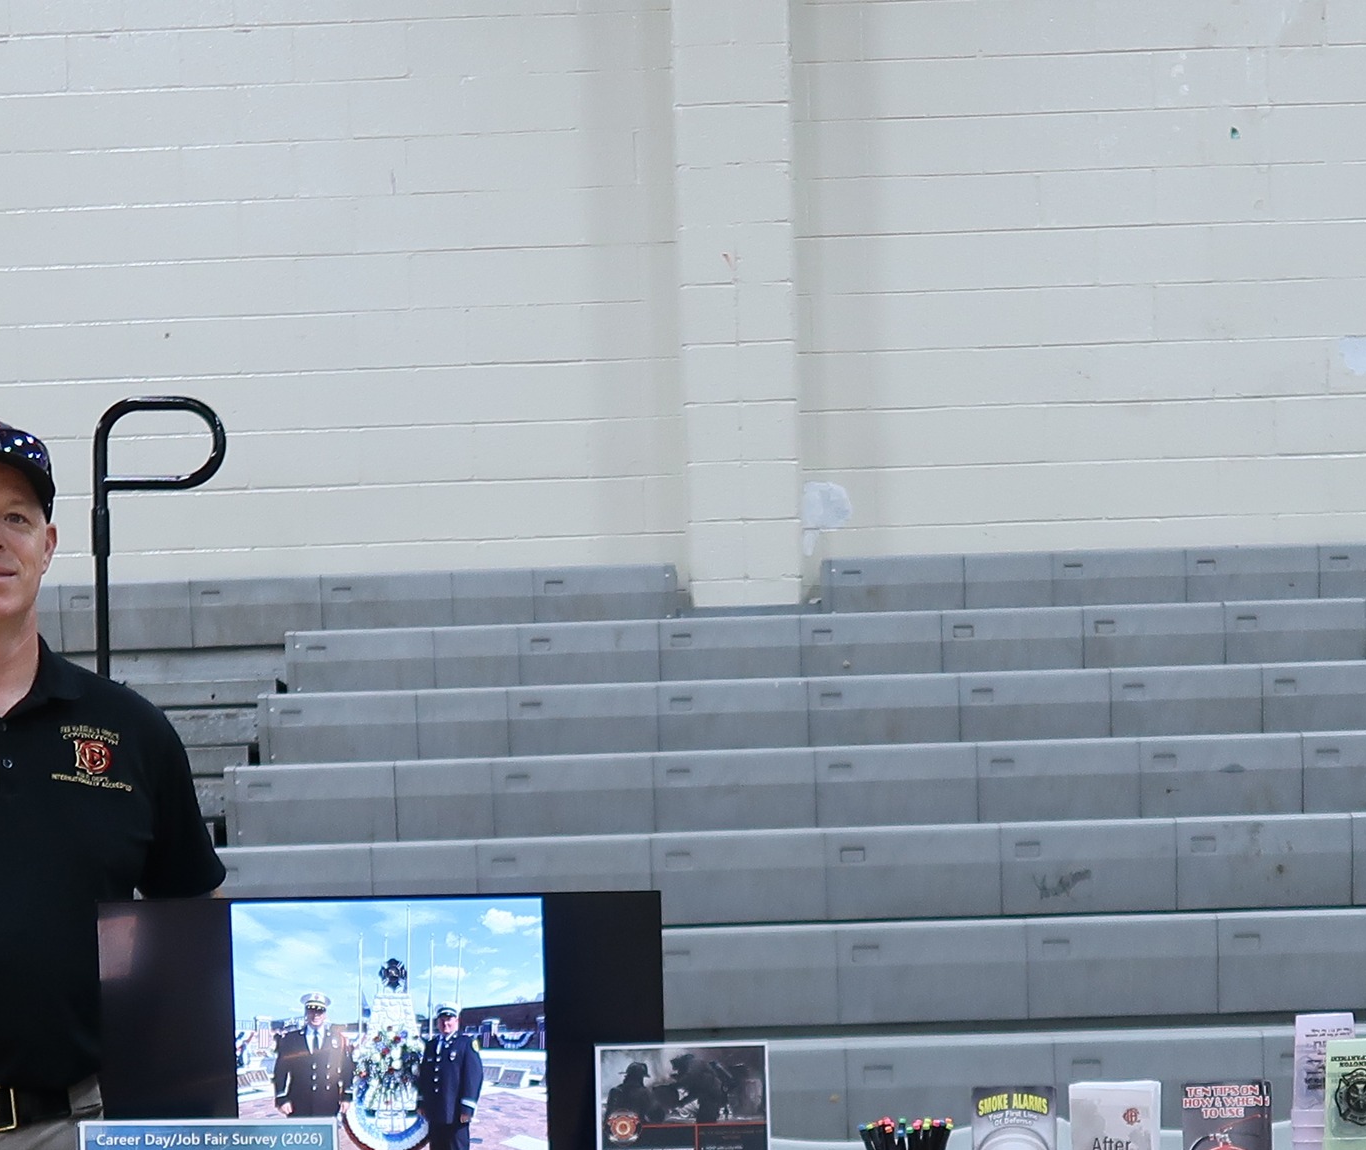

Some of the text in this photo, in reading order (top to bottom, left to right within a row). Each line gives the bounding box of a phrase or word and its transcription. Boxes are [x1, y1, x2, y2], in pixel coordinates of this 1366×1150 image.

[1186, 1084, 1259, 1097] TEN TIPS ON
[978, 1093, 1048, 1116] SMOKE ALARMS
[1183, 1097, 1214, 1109] HOW
[1223, 1095, 1263, 1107] WHEN
[1202, 1107, 1245, 1119] TO USE
[96, 1132, 323, 1149] Career Day/Job Fair Survey (2026)
